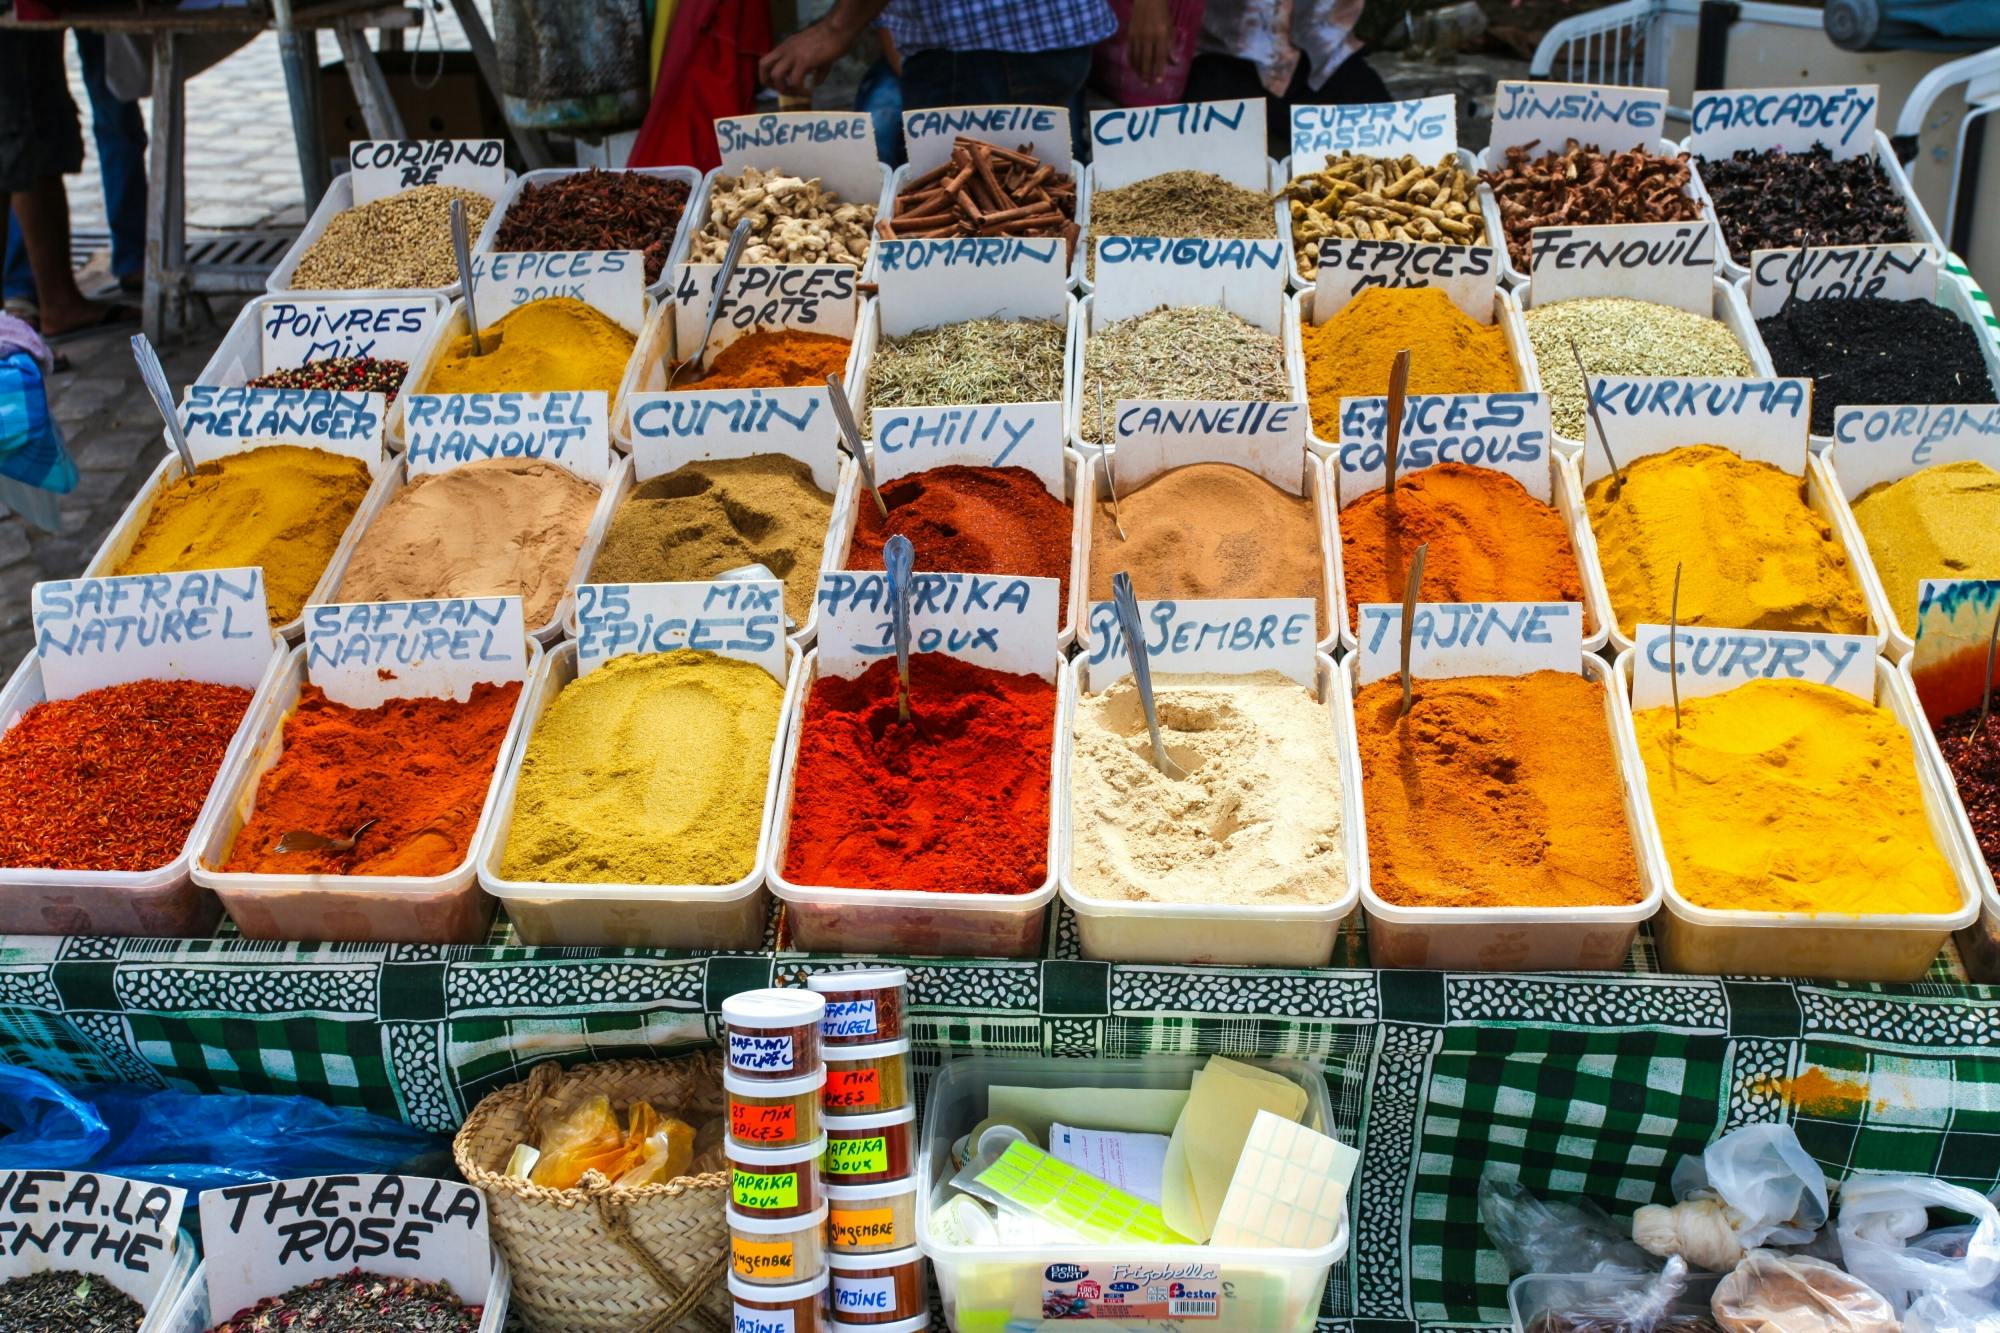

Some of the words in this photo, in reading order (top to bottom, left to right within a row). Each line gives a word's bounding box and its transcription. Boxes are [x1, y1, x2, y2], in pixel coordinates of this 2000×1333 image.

[1293, 101, 1424, 131] CURRY
[1293, 114, 1447, 153] RASSING
[401, 165, 443, 187] RE
[878, 239, 1057, 271] ROMARIN
[1100, 236, 1287, 270] ORIGUAN
[511, 284, 585, 304] DOUX
[677, 266, 699, 305] 4
[1809, 274, 1886, 303] OIR
[707, 298, 819, 329] FORTS
[186, 385, 368, 412] SAFRAN
[1587, 380, 1804, 417] KURKUMA
[183, 407, 377, 440] MELANGER
[407, 426, 586, 465] HANOUT
[37, 569, 257, 628] SAFRAN
[577, 585, 630, 625] 25
[36, 605, 253, 658] NATUREL
[311, 598, 507, 638] SAFRAN
[308, 621, 512, 669] NATUREL
[1646, 634, 1861, 685] CURRY
[824, 1001, 873, 1018] FRAN
[823, 1018, 877, 1036] ATUREL
[733, 1107, 745, 1119] 25
[831, 1159, 872, 1173] DOUX
[739, 1194, 778, 1207] DOUX
[277, 1217, 434, 1265] ROSE
[1079, 1286, 1099, 1294] 100%
[1112, 1263, 1217, 1287] Frigobella
[1077, 1291, 1099, 1299] ITALY
[1169, 1282, 1217, 1300] Bestar
